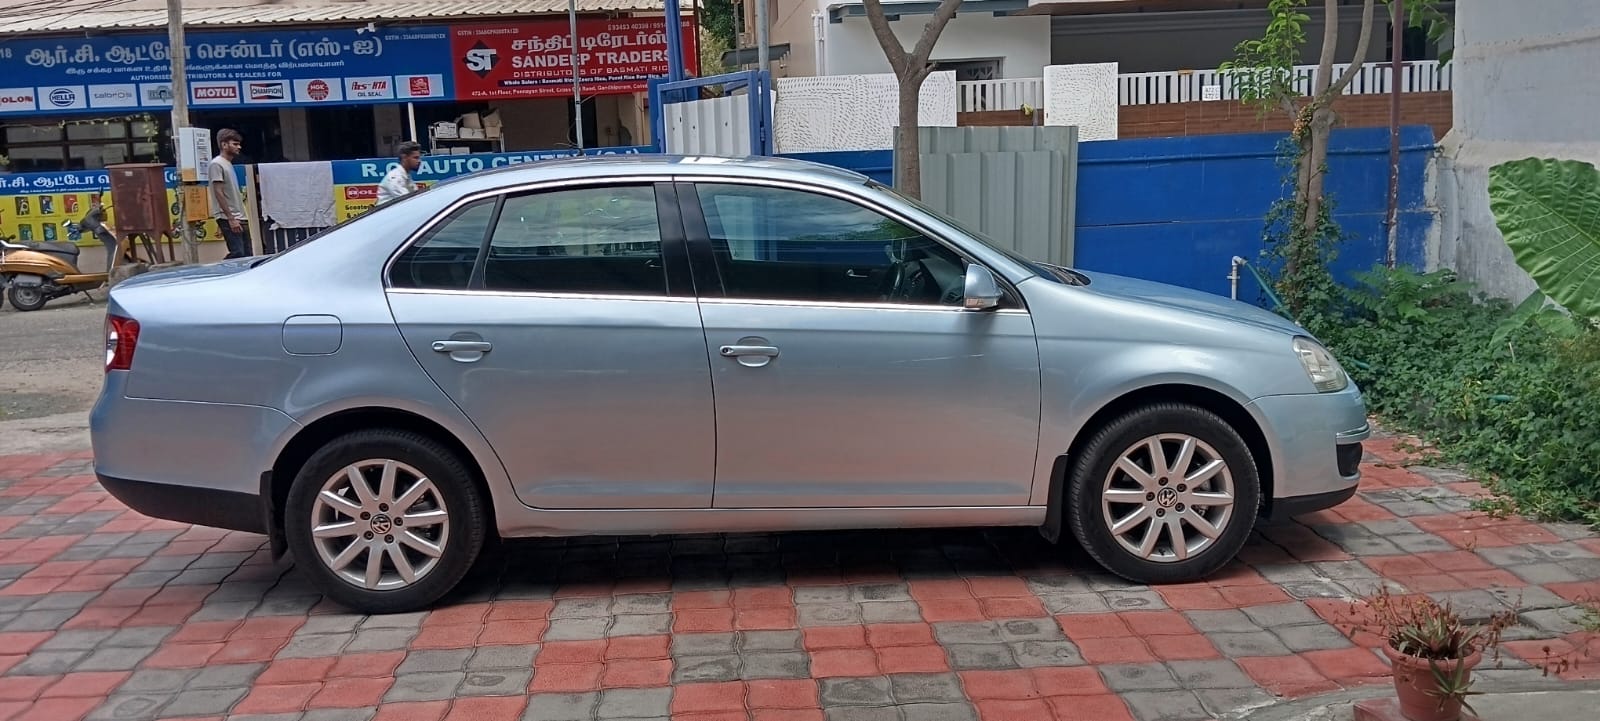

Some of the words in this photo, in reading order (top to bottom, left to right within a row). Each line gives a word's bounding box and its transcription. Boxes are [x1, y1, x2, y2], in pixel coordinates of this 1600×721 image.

[25, 44, 100, 68] ஆர்.சி.
[197, 39, 284, 60] சென்டர்
[466, 48, 497, 71] ST
[513, 69, 587, 78] DISTRIBUTOS
[606, 65, 648, 74] BASMATI
[0, 95, 33, 104] OLON
[51, 93, 76, 101] HELLA
[196, 87, 236, 98] MOTUL
[416, 157, 485, 176] AUTO
[0, 176, 30, 189] ர்.சி.
[33, 174, 95, 188] ஆட்டோ
